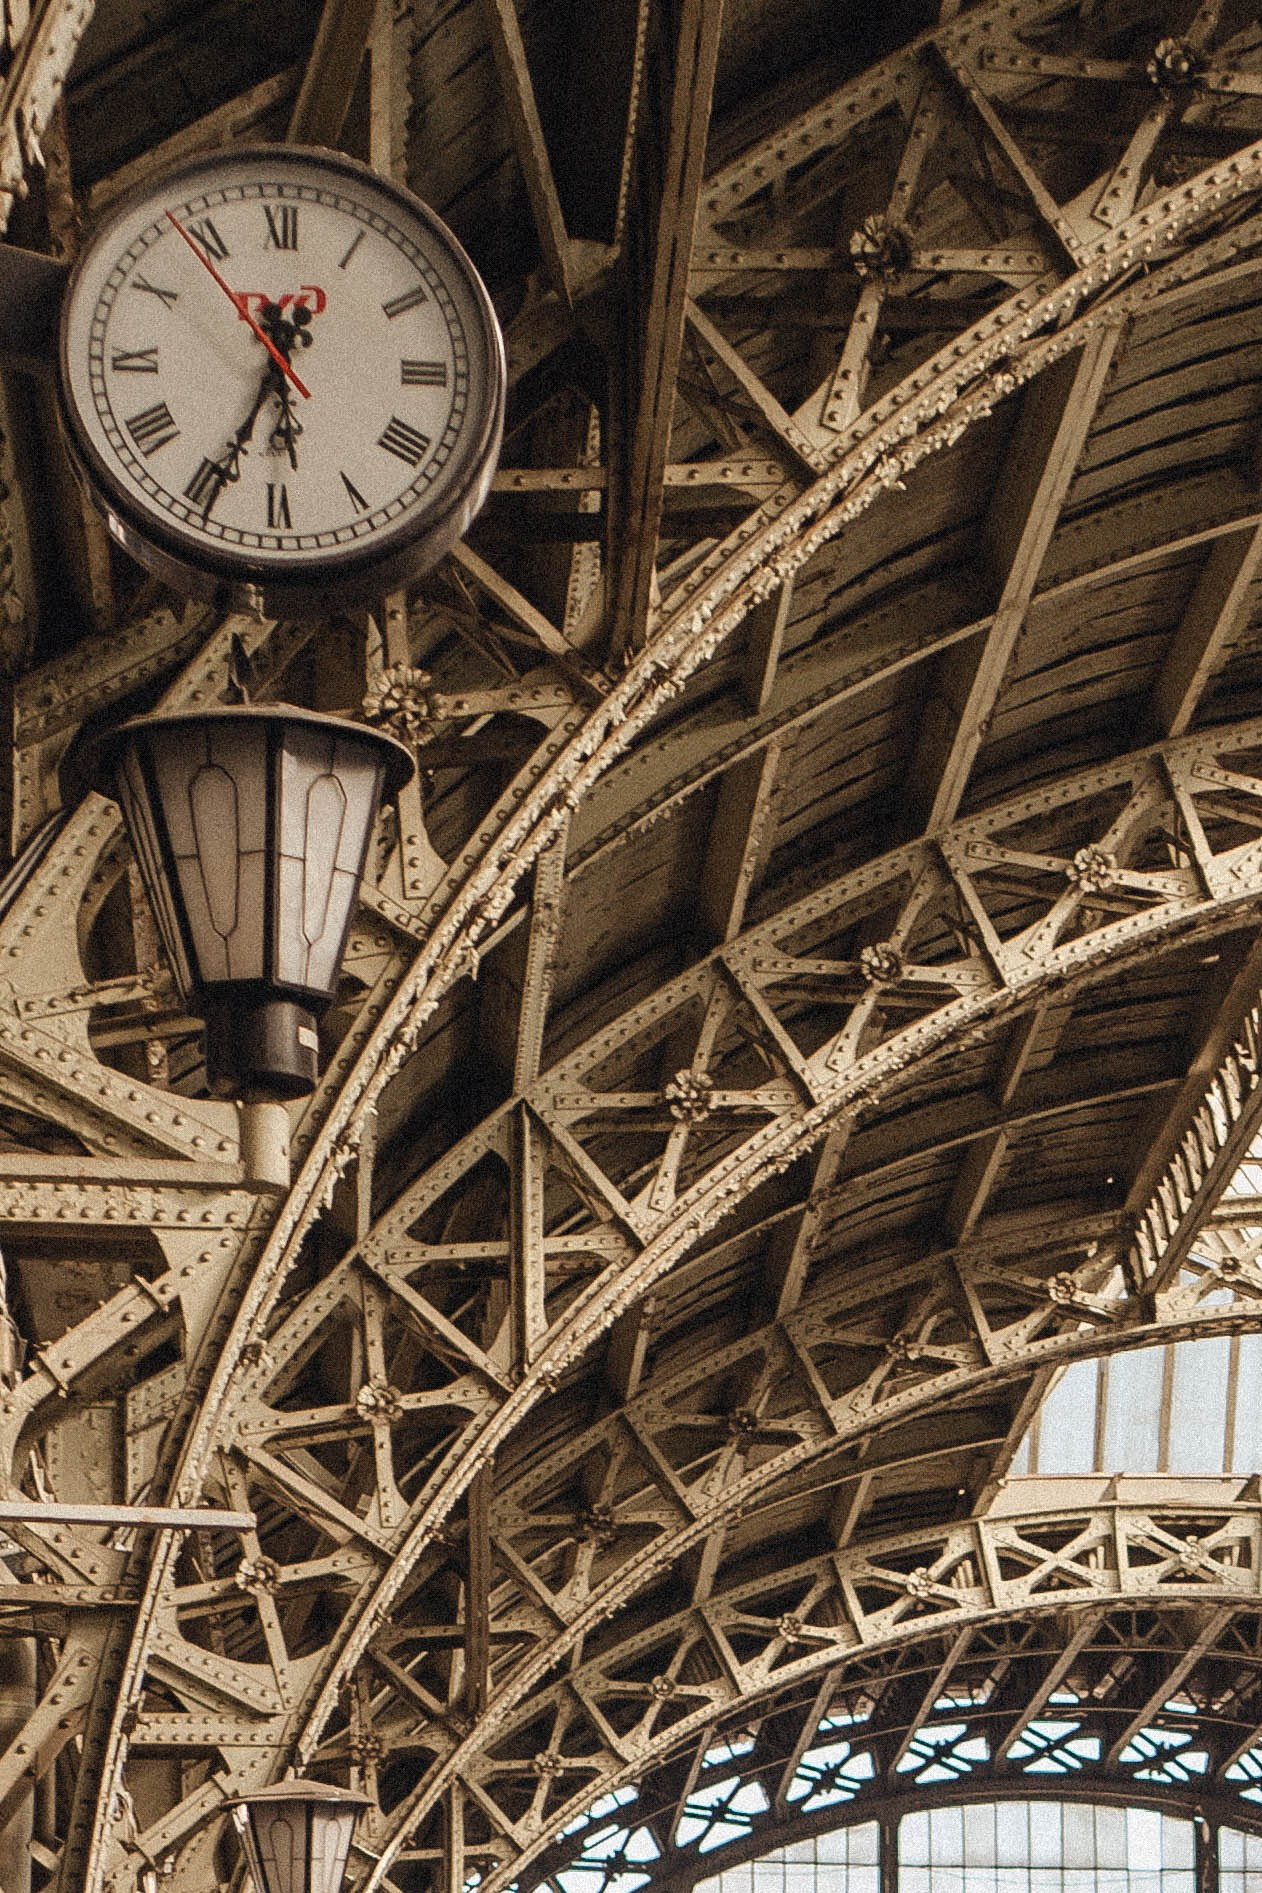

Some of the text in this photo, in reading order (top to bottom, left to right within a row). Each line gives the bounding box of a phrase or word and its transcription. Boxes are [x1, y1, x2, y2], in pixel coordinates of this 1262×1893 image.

[188, 216, 230, 262] XI
[263, 204, 298, 250] XII
[132, 273, 178, 313] X
[382, 284, 429, 321] II
[111, 346, 159, 373] IX
[400, 359, 447, 388] III
[125, 400, 180, 458] VIII
[265, 482, 292, 529] VI
[339, 470, 370, 515] V
